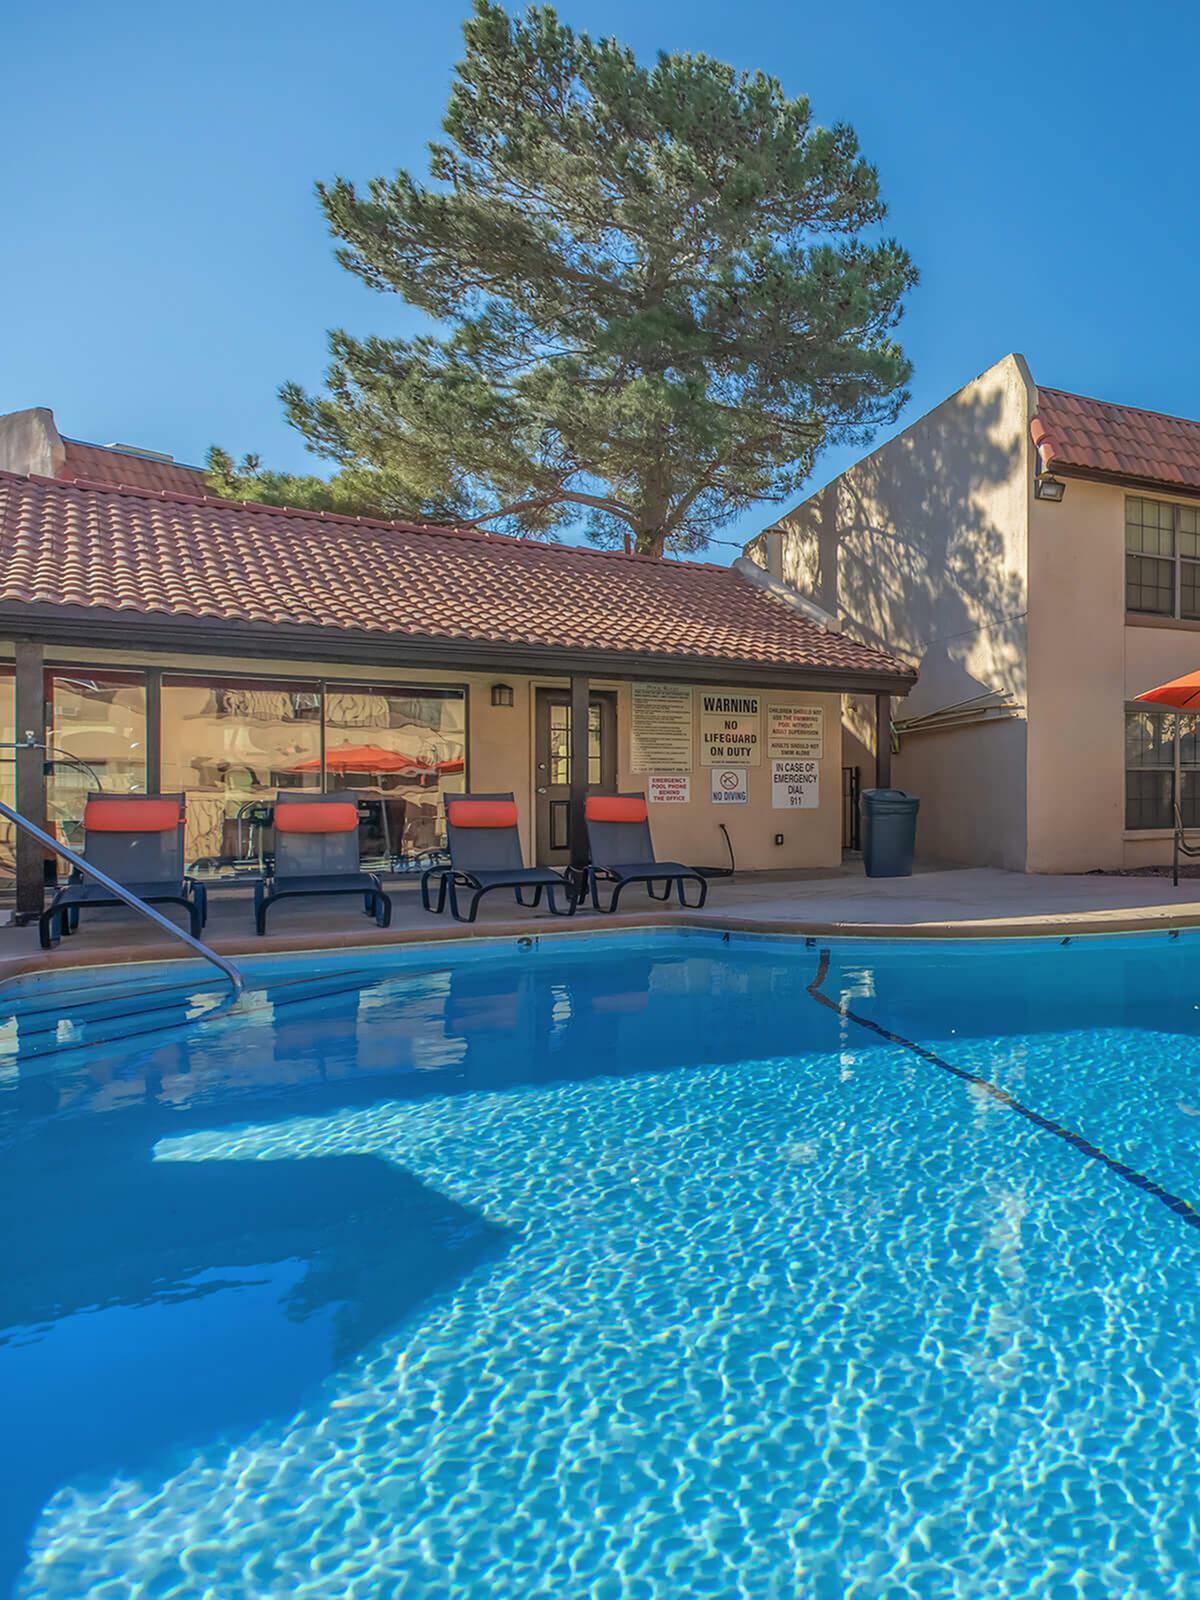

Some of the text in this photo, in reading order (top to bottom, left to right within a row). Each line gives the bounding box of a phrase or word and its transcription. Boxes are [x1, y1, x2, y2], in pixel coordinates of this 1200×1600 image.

[703, 696, 758, 713] WARNING
[724, 720, 738, 730] NO
[704, 733, 757, 744] LIFEGUARD
[710, 747, 752, 757] ON DUTY
[776, 762, 815, 772] IN CASE OF
[774, 774, 818, 783] EMERGENCY
[788, 785, 804, 794] DIAL
[713, 791, 746, 801] NO DIVING
[790, 796, 802, 805] 911
